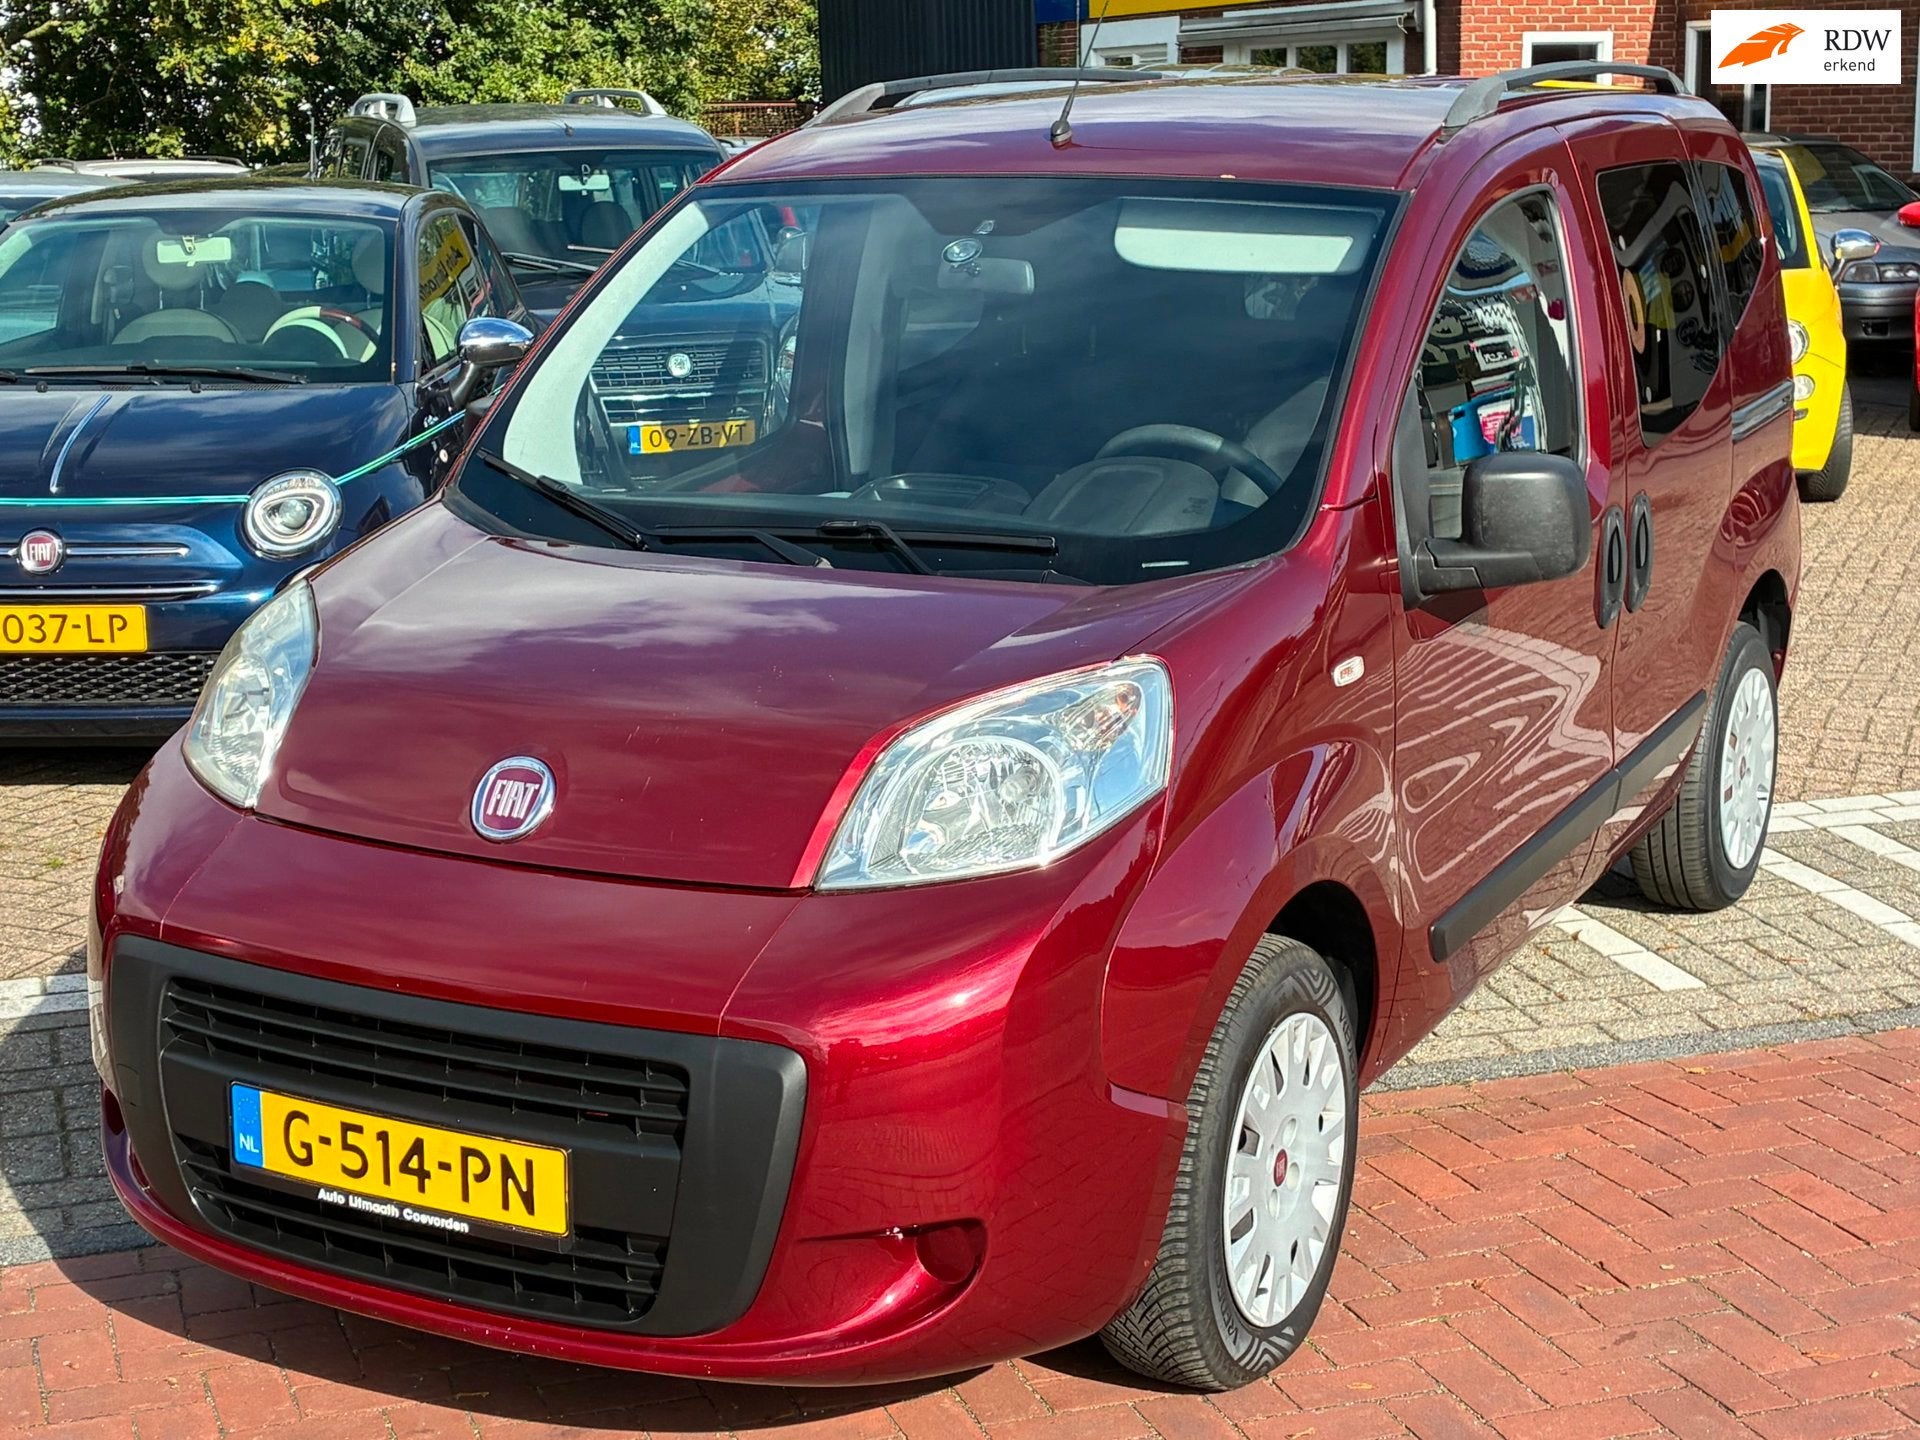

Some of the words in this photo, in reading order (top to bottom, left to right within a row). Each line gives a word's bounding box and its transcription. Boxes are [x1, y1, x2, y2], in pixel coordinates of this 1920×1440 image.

[649, 423, 747, 448] 09-ZB-VT
[29, 542, 52, 561] FIAT
[2, 614, 128, 643] 037-LP
[486, 779, 540, 819] FIAT
[239, 1134, 259, 1154] NL
[283, 1109, 535, 1217] G-514-PN
[317, 1187, 346, 1205] Auto
[402, 1207, 470, 1234] Coevorden
